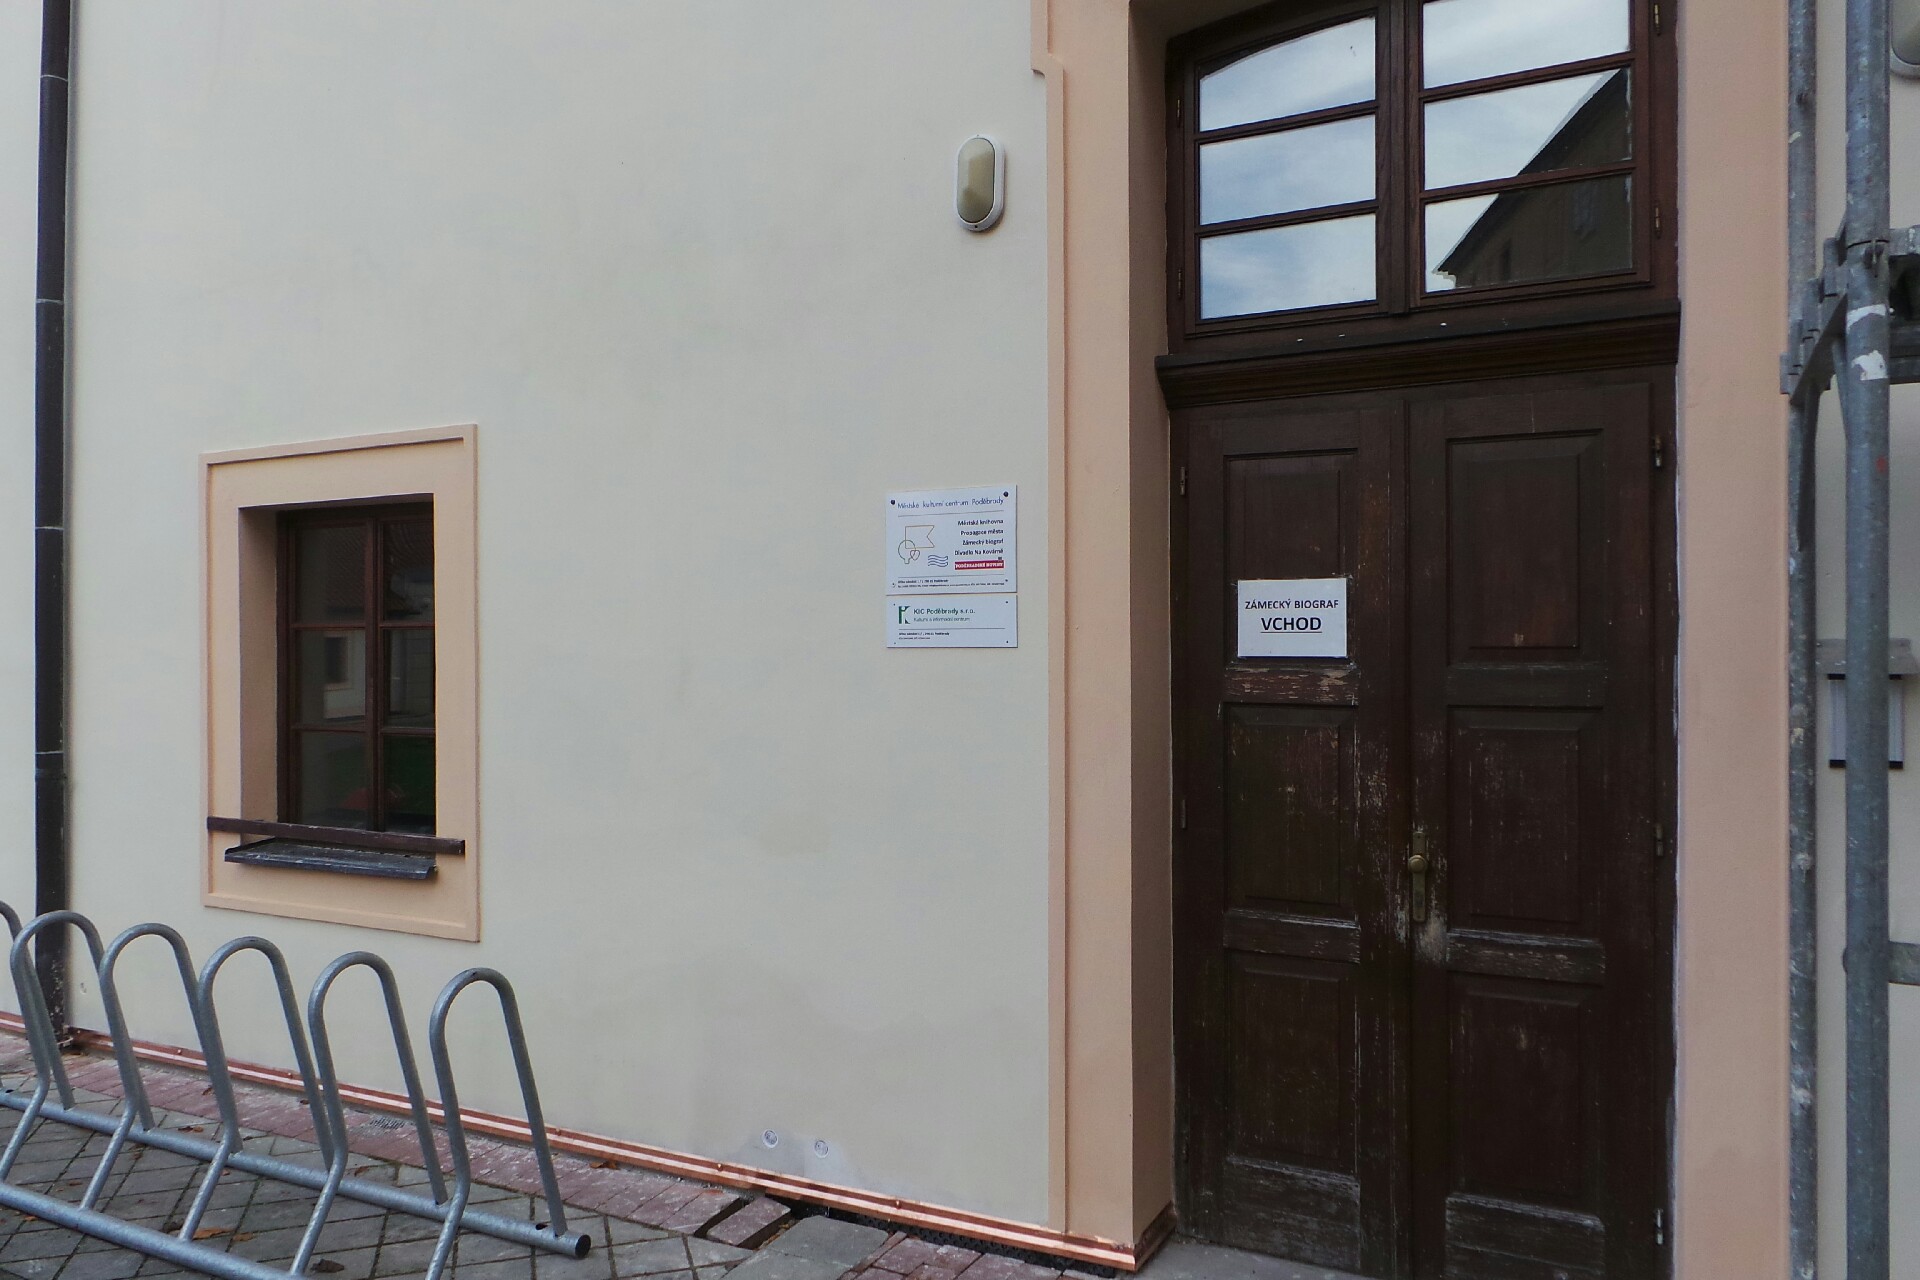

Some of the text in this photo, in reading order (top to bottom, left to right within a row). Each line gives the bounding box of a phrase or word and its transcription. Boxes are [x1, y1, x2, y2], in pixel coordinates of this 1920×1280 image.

[972, 497, 1004, 505] Poděbrady
[1245, 598, 1339, 609] ZÁMECKÝ BIOGRAF
[926, 607, 959, 616] Poděbrady
[1260, 617, 1322, 631] VCHOD
